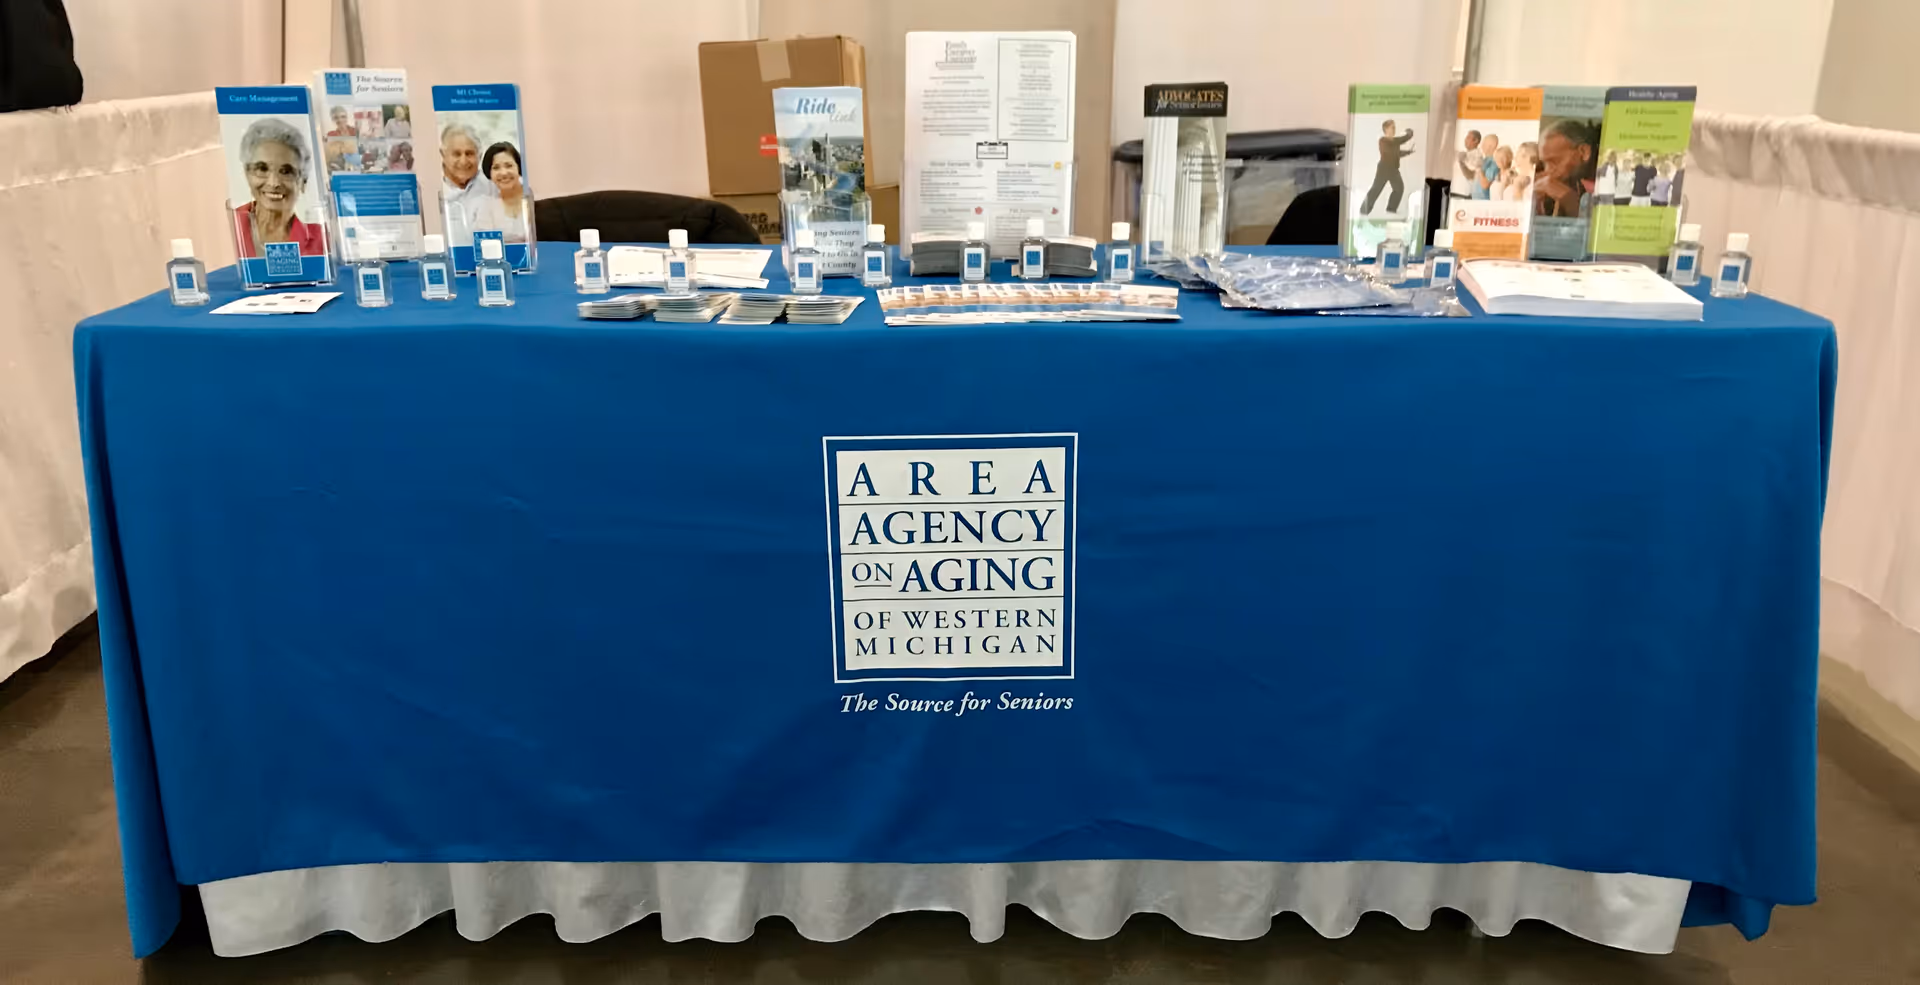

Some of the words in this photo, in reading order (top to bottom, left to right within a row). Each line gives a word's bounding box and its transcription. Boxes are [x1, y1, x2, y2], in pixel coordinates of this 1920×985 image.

[249, 94, 298, 103] Management
[795, 97, 836, 114] Ride
[1158, 89, 1224, 101] ADVOCATES
[1473, 217, 1519, 227] FITNESS
[836, 239, 854, 248] They
[846, 459, 1056, 497] AREA
[848, 508, 1057, 545] AGENCY
[851, 562, 894, 582] ON
[898, 556, 1056, 592] AGING
[853, 611, 891, 630] OF
[901, 608, 1056, 629] WESTERN
[855, 634, 1056, 656] MICHIGAN
[840, 693, 877, 713] The
[884, 693, 953, 713] Source
[955, 691, 991, 716] for
[996, 691, 1074, 711] Seniors
